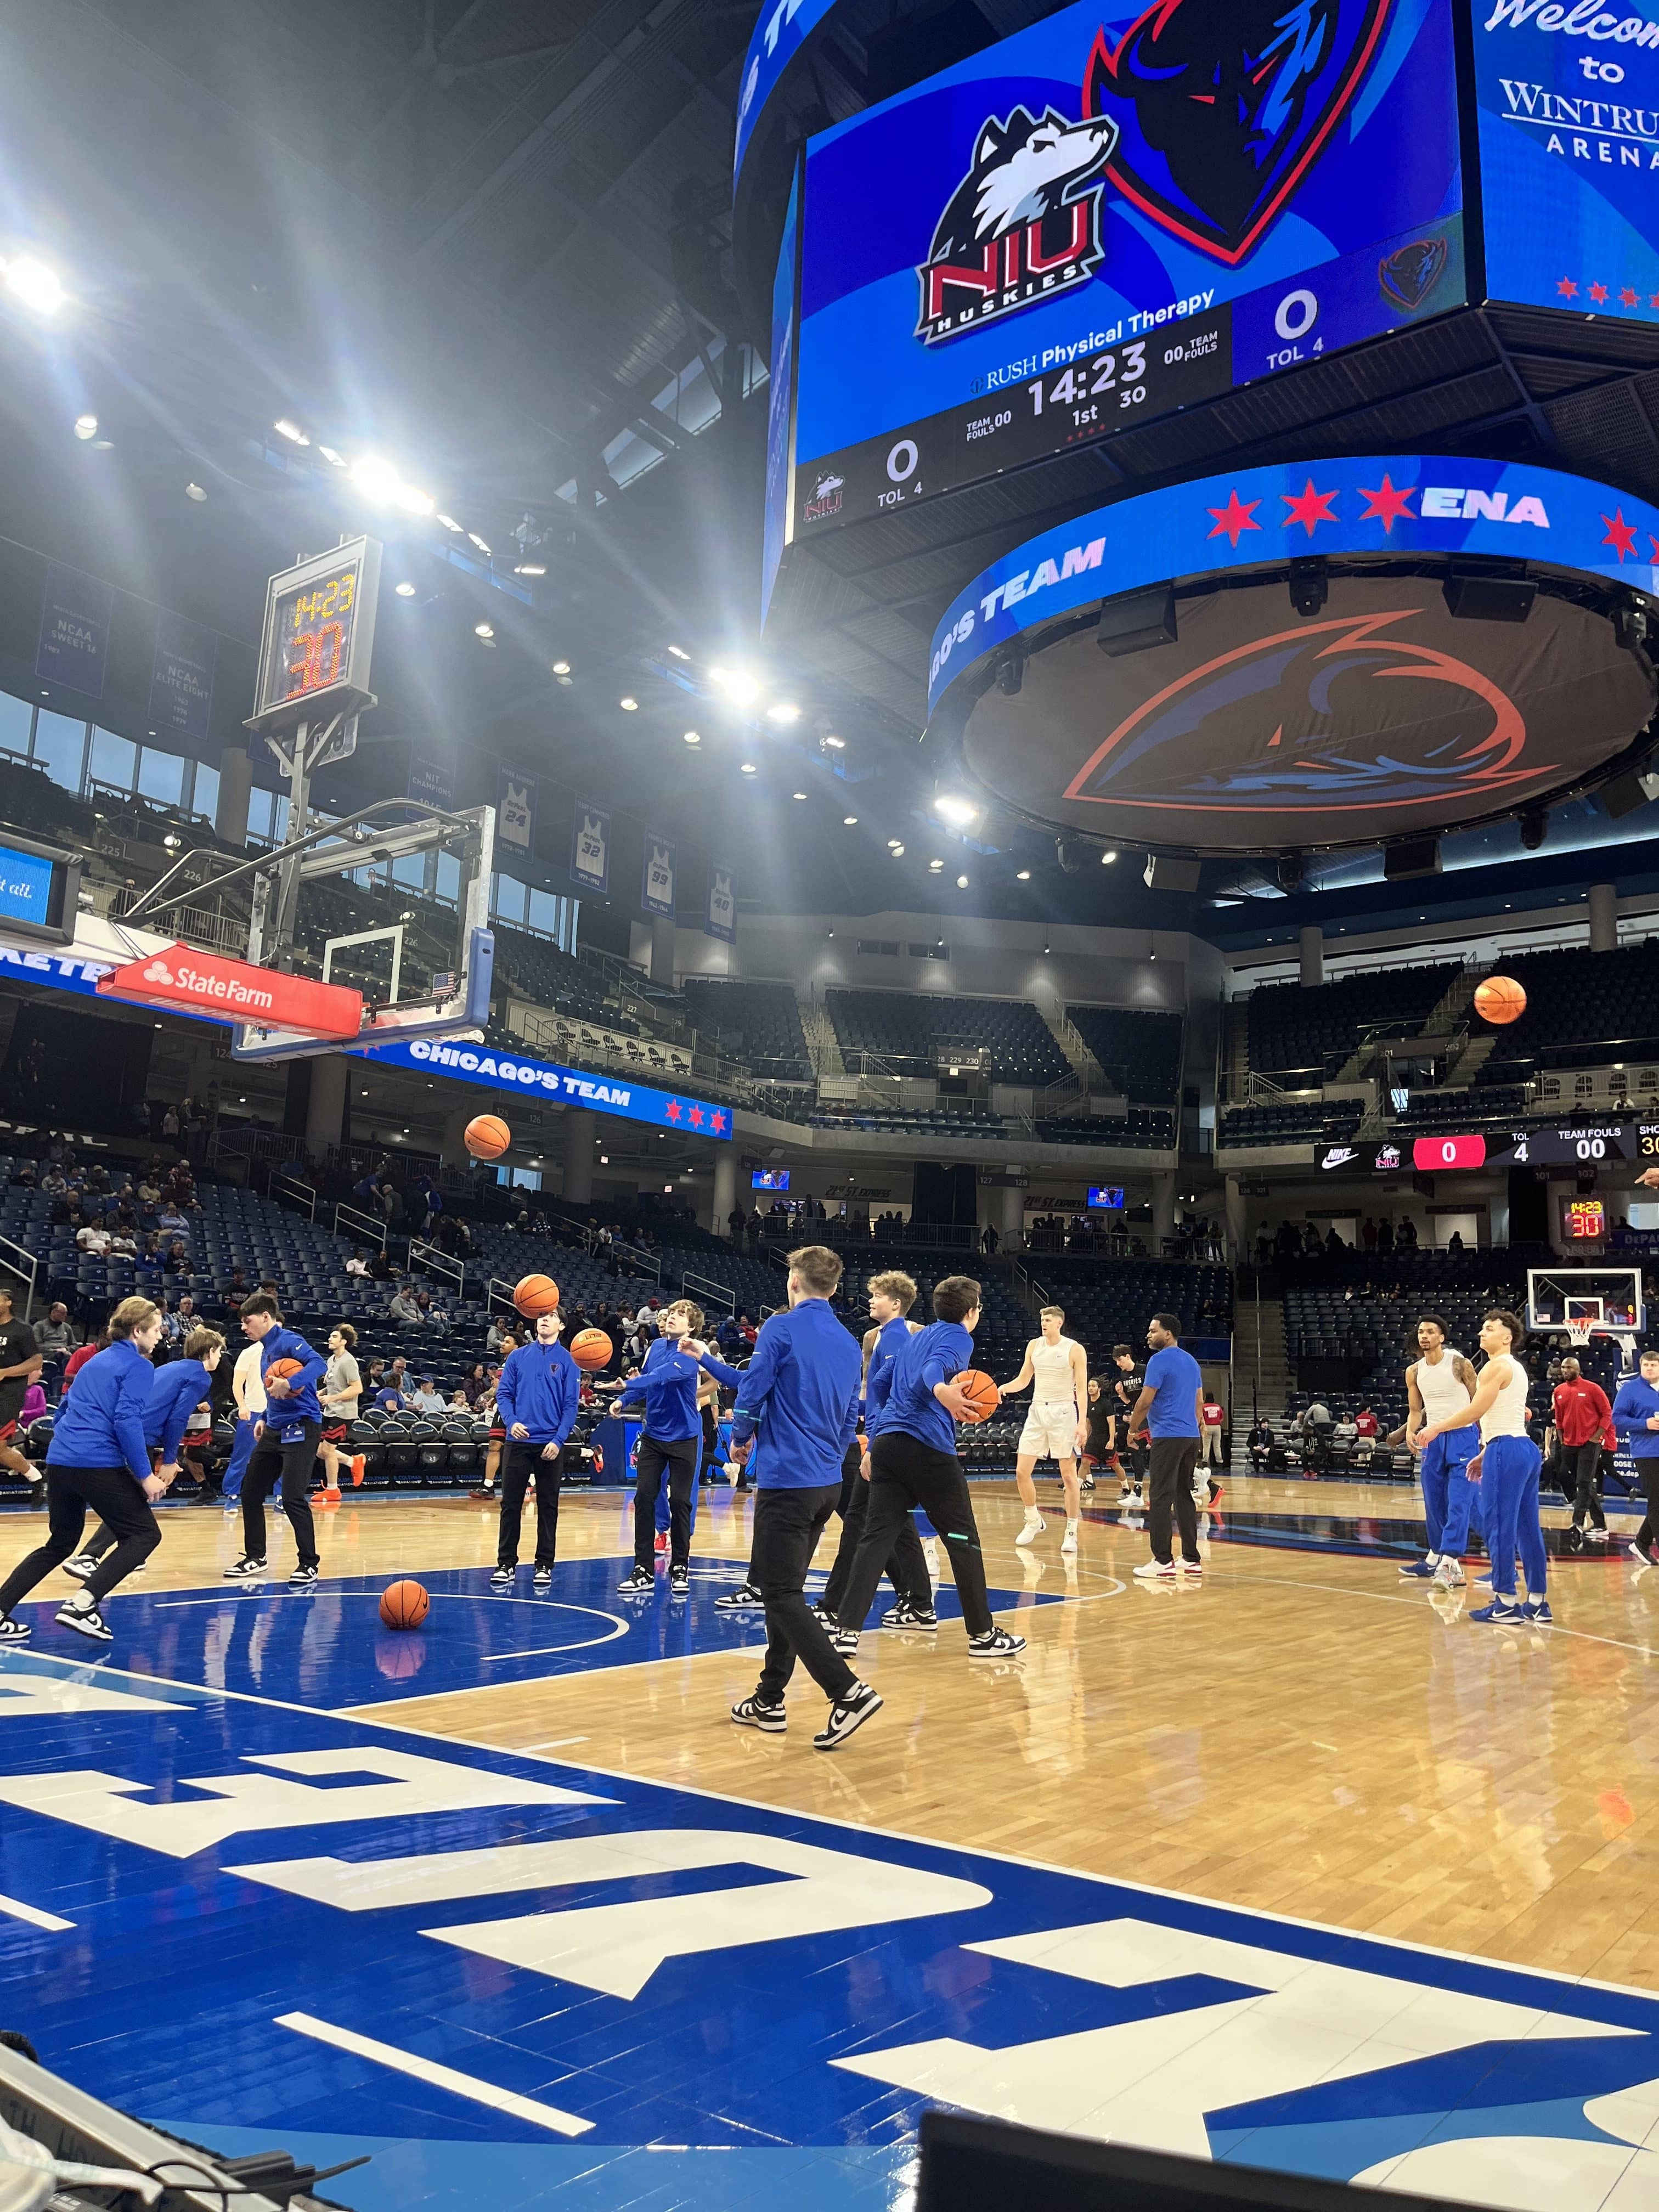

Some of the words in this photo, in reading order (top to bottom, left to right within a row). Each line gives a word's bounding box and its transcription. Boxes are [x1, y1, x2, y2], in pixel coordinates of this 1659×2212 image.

[1579, 57, 1624, 83] to
[927, 201, 1087, 320] NIU
[938, 265, 1077, 332] HUSKIES
[1274, 289, 1317, 340] 0
[988, 356, 1036, 390] RUSH
[1042, 322, 1121, 368] Physical
[1128, 289, 1214, 332] Therapy
[1189, 331, 1218, 347] TEAM
[1164, 345, 1184, 365] 00
[1184, 341, 1217, 362] FOULS
[1266, 348, 1304, 370] TOL
[1312, 337, 1324, 352] 4
[1028, 341, 1146, 415] 14:23
[1120, 386, 1146, 408] 30
[967, 416, 990, 432] TEAM
[995, 410, 1012, 427] 00
[1073, 405, 1097, 426] 1st
[967, 425, 995, 442] FOULS
[887, 439, 918, 482] 0
[878, 490, 905, 507] TOL
[913, 482, 922, 494] 4
[806, 494, 842, 518] NIU
[1421, 488, 1550, 528] ENA
[295, 574, 354, 627] 14:23
[928, 610, 975, 692] GO'S
[980, 537, 1105, 622] TEAM
[58, 620, 92, 642] NCAA
[52, 630, 83, 649] SWEET
[88, 644, 97, 654] 16
[286, 621, 342, 700] 30
[168, 665, 198, 685] NCAA
[156, 672, 181, 689] ELITE
[183, 684, 209, 700] EIGHT
[413, 777, 452, 798] CHAMPIONS
[426, 772, 440, 784] NIT
[505, 809, 527, 827] 24
[101, 844, 120, 857] 225
[582, 842, 601, 857] 32
[184, 870, 201, 882] 226
[652, 871, 668, 885] 99
[714, 897, 729, 911] 40
[404, 936, 418, 947] 226
[409, 1040, 559, 1091] CHICAGO'S
[562, 1076, 630, 1107] TEAM
[496, 1108, 509, 1118] 125
[530, 1114, 541, 1124] 126
[1558, 1130, 1585, 1139] TEAM
[1588, 1127, 1622, 1138] FOULS
[1328, 1148, 1352, 1160] NIKE
[1442, 1142, 1457, 1163] 0
[1514, 1143, 1529, 1162] 4
[1576, 1139, 1605, 1159] 00
[1377, 1158, 1398, 1166] NIU
[1571, 1201, 1601, 1214] 14:23
[1572, 1215, 1600, 1238] 30
